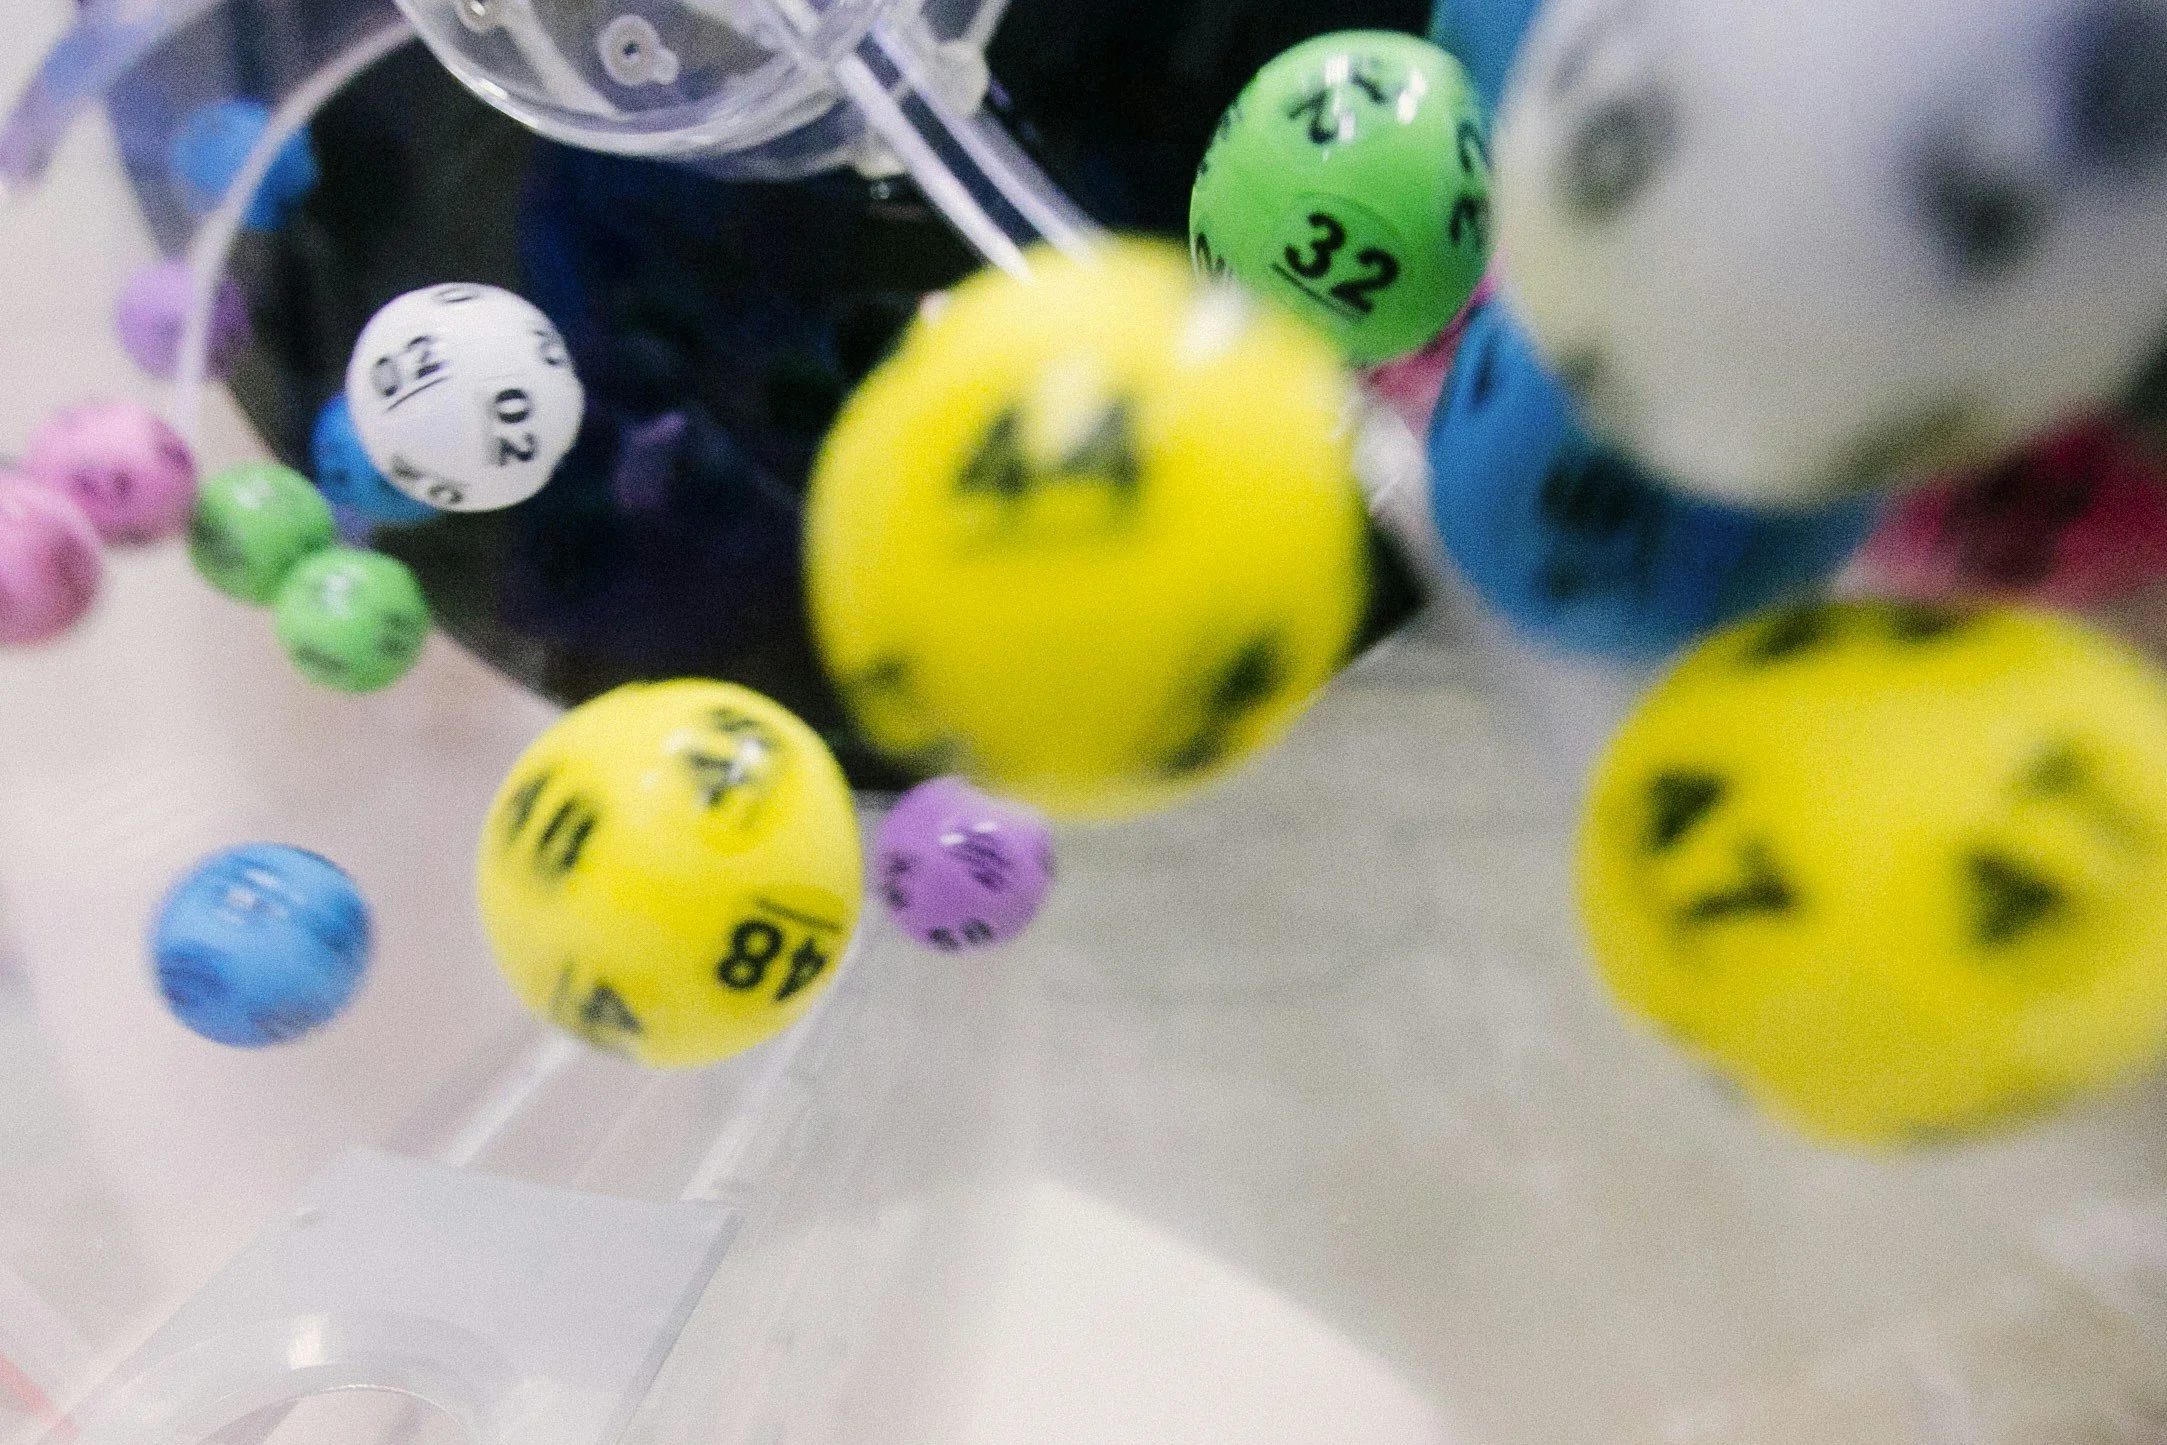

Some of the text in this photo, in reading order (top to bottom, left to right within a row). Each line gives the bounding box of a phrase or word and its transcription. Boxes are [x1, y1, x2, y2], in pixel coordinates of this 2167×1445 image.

[1285, 211, 1399, 315] 32
[490, 387, 539, 467] 02
[715, 918, 830, 1006] 48
